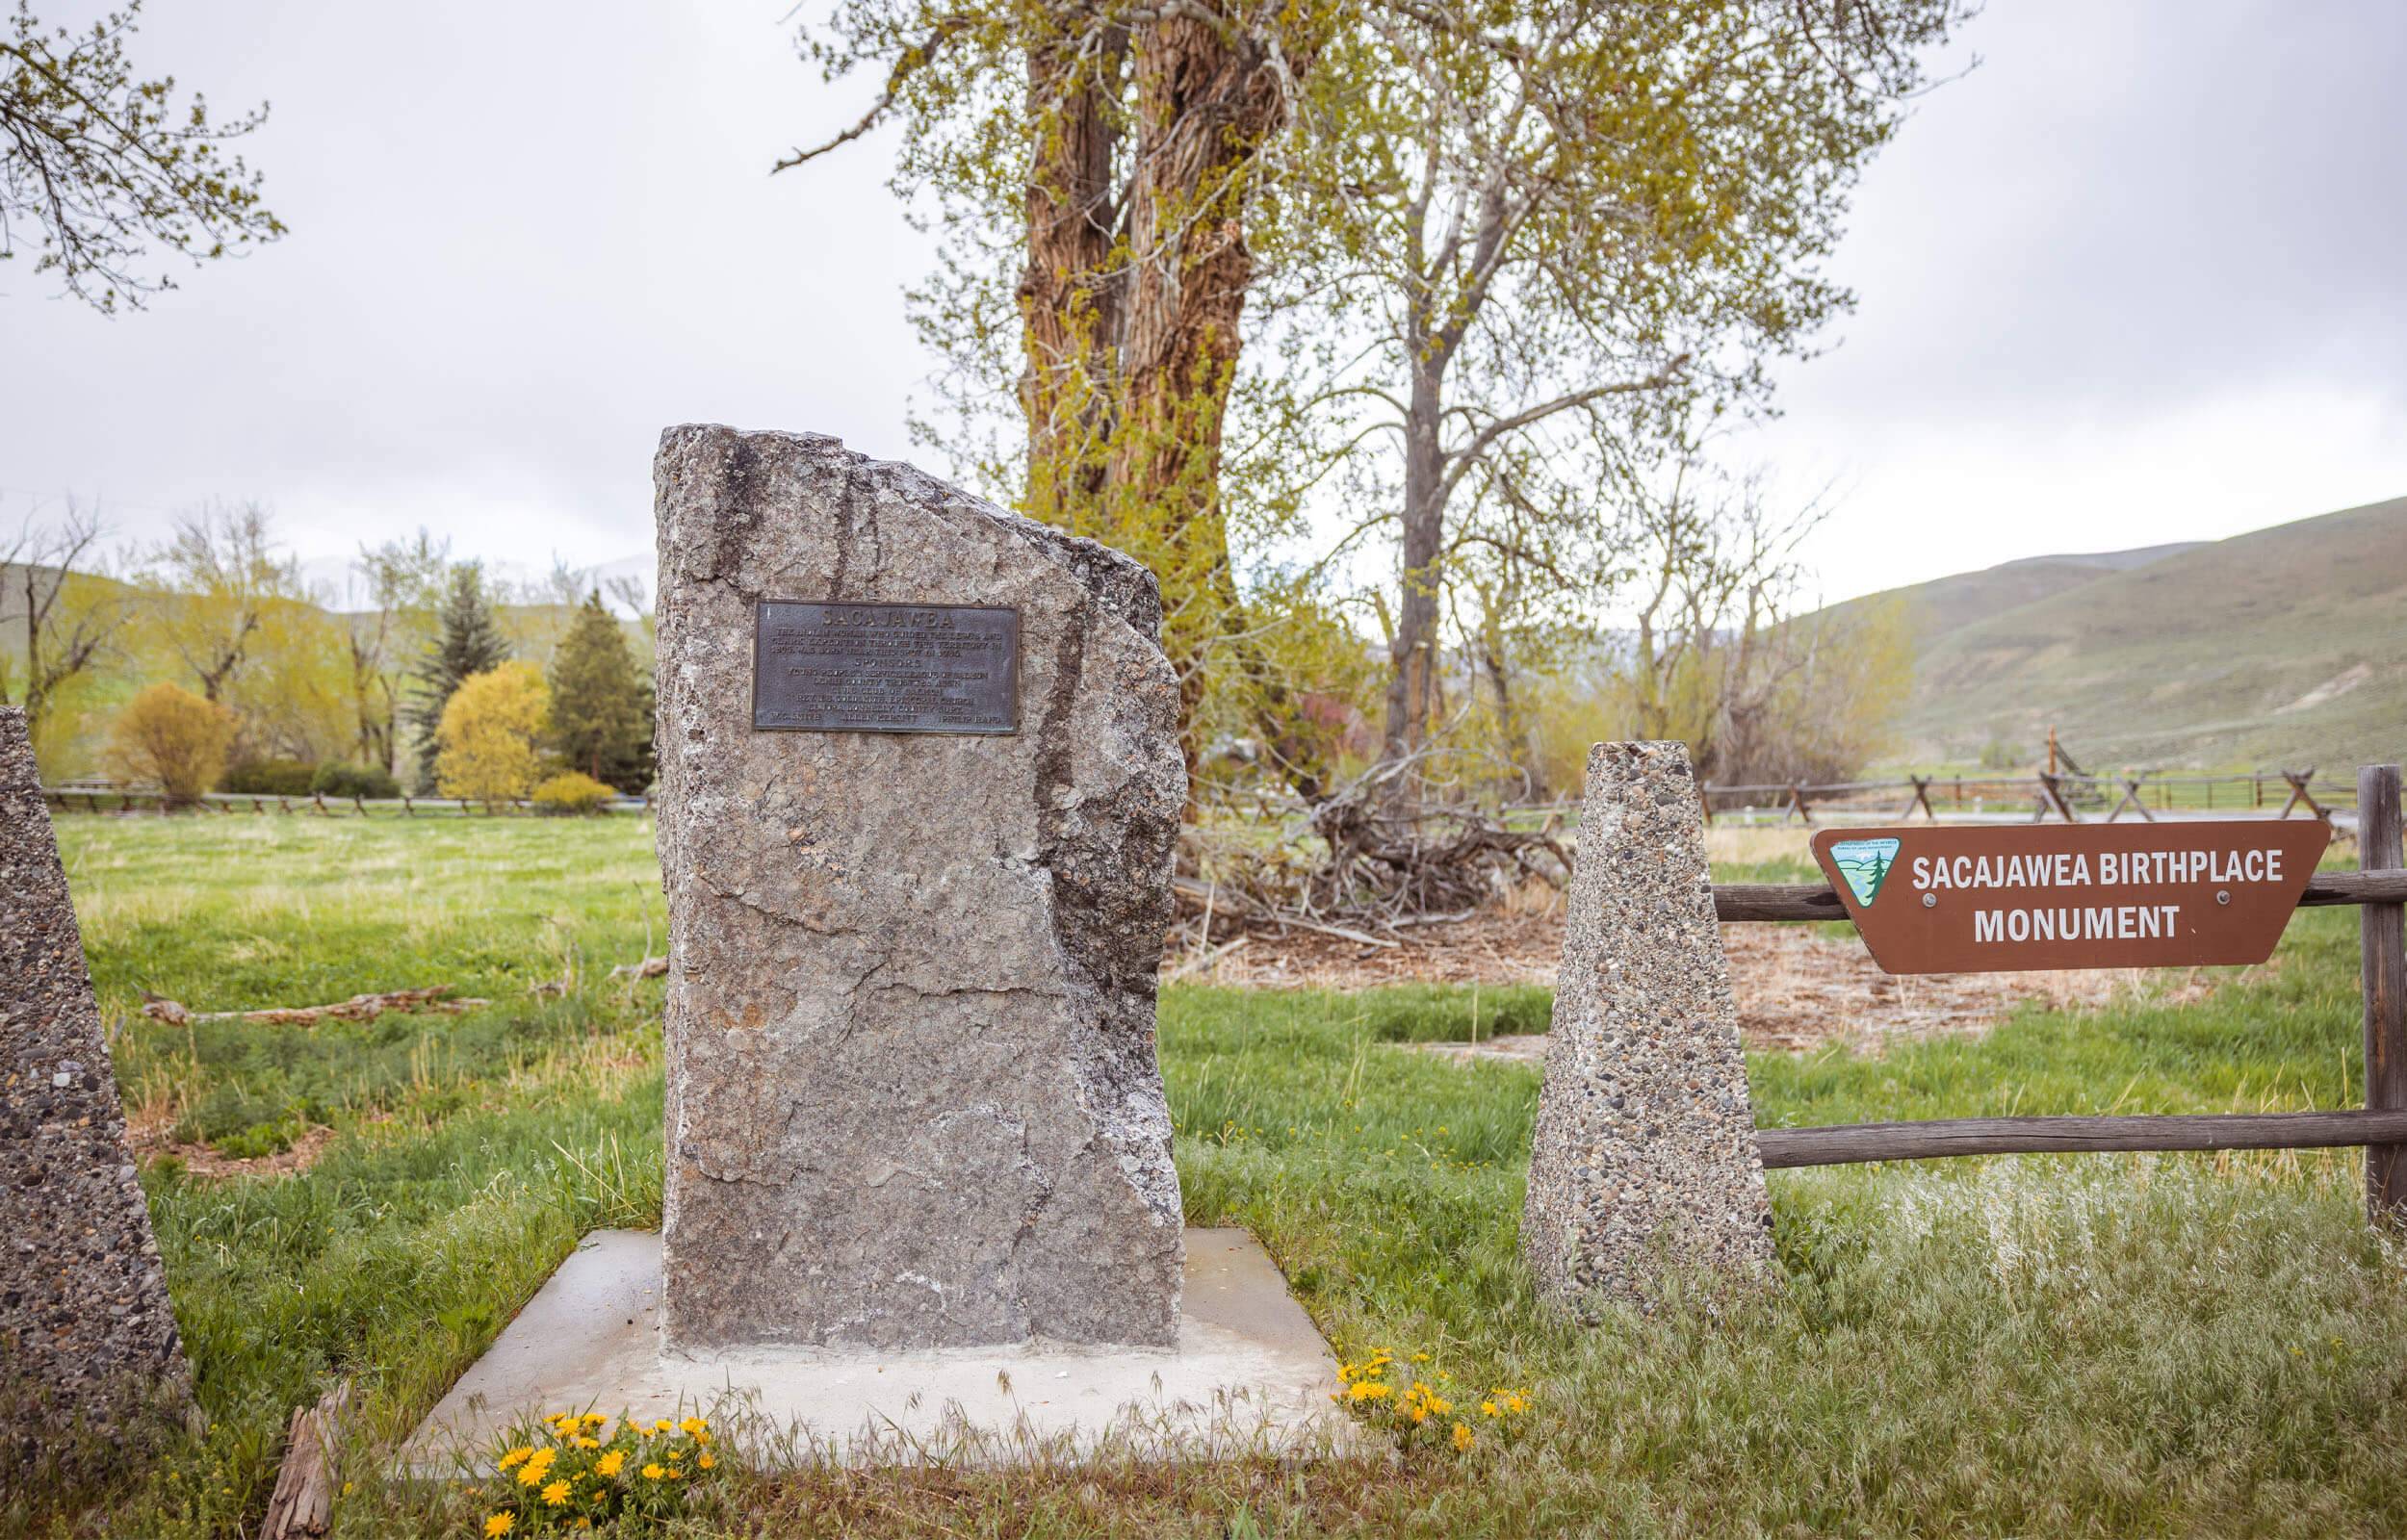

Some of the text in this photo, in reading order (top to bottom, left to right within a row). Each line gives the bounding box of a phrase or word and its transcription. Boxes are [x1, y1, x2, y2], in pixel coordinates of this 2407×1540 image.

[822, 610, 955, 629] SACAJAWEA
[939, 641, 988, 650] TERRITORY
[855, 658, 921, 667] SPONSORS
[1912, 849, 2284, 889] SACAJAWEA BIRTHPLACE
[1974, 905, 2181, 942] MONUMENT
